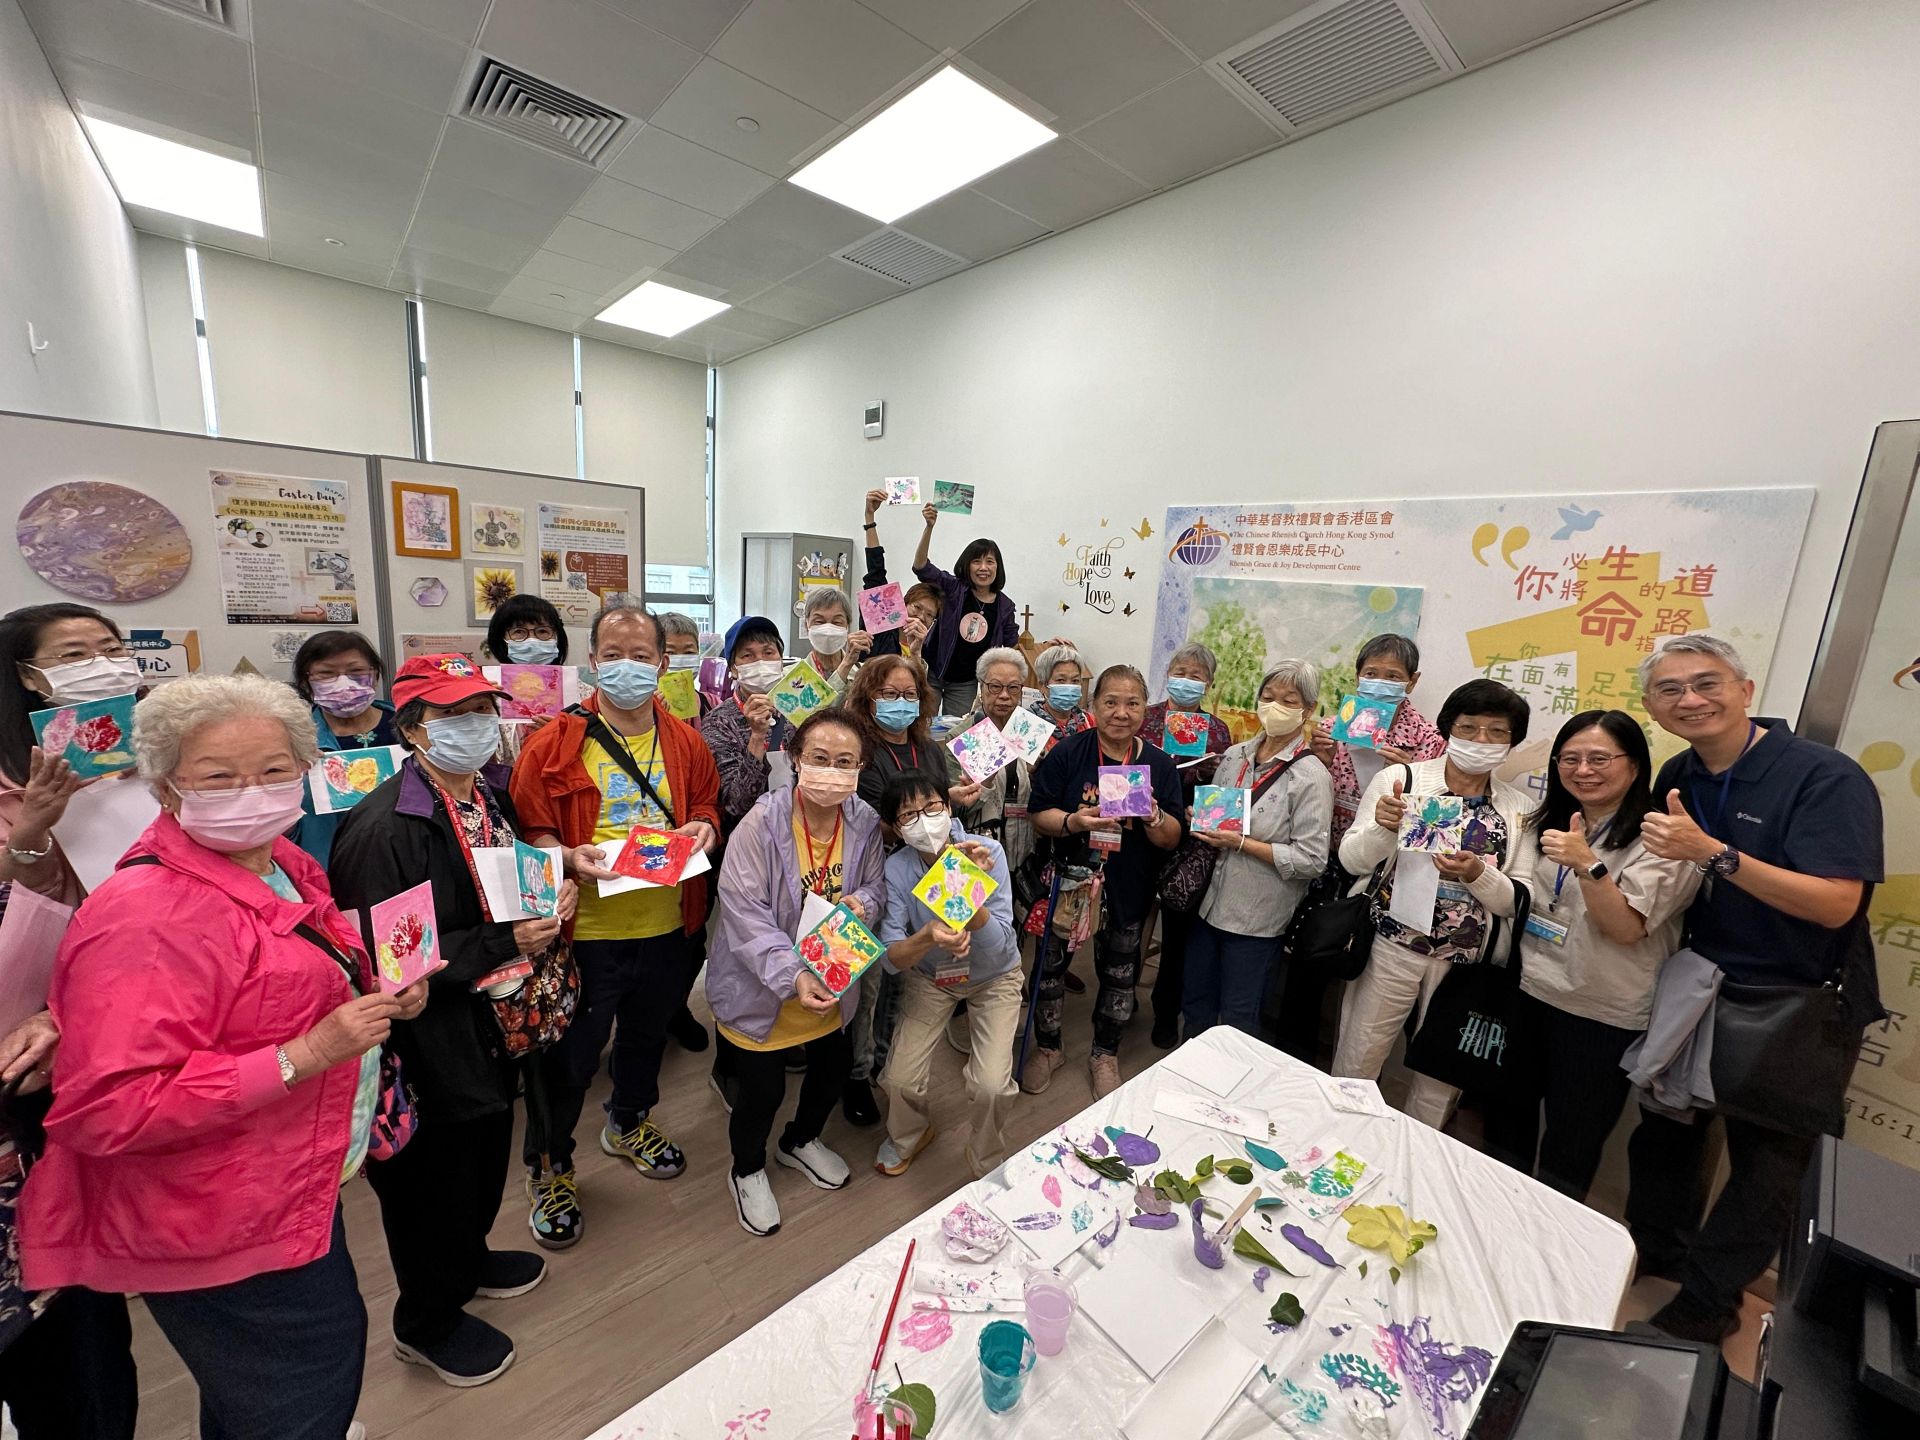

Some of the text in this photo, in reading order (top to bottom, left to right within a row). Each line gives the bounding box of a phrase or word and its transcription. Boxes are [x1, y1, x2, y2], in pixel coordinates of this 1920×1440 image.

[278, 488, 337, 505] Easter Day
[1235, 511, 1394, 526] 中華基督教禮賢會香港區會
[1271, 531, 1298, 539] Rhenish
[1299, 531, 1324, 539] Church
[1326, 531, 1346, 540] Hong
[1347, 531, 1368, 540] Kong
[1369, 530, 1394, 540] Synod
[1231, 543, 1345, 558] 禮賢會恩樂成長中心
[1253, 560, 1271, 568] Grace
[1279, 561, 1291, 570] Joy
[1292, 562, 1337, 571] Development
[1337, 562, 1361, 571] Centre
[1062, 562, 1093, 588] Hope
[1085, 582, 1115, 614] Love
